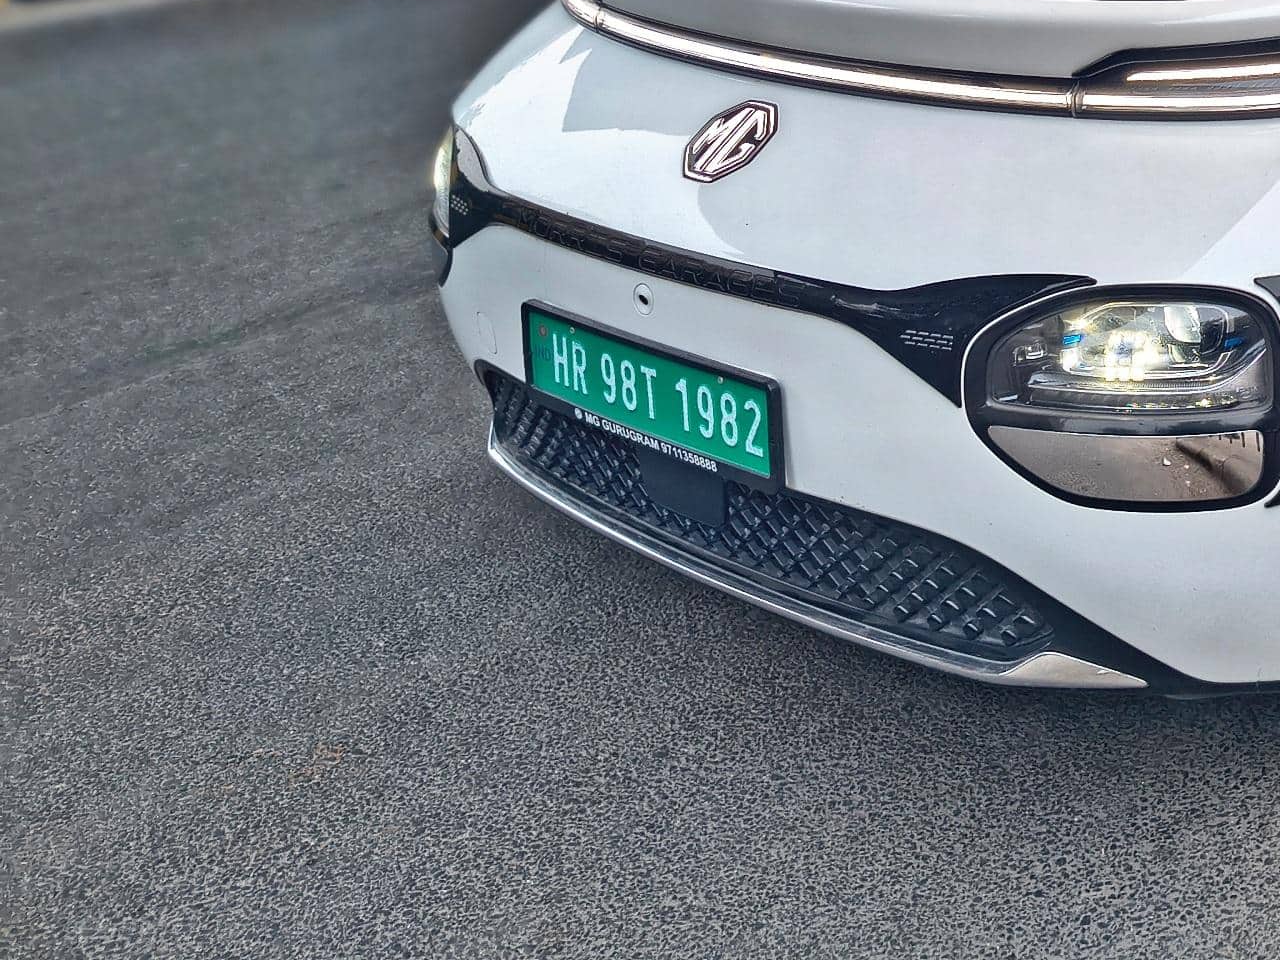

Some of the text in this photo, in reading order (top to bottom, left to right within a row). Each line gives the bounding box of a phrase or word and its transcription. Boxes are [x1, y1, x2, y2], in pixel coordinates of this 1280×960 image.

[688, 104, 770, 175] MG
[552, 333, 764, 458] HR 98T 1982
[584, 412, 600, 427] MG
[601, 419, 659, 451] GURUGRAM
